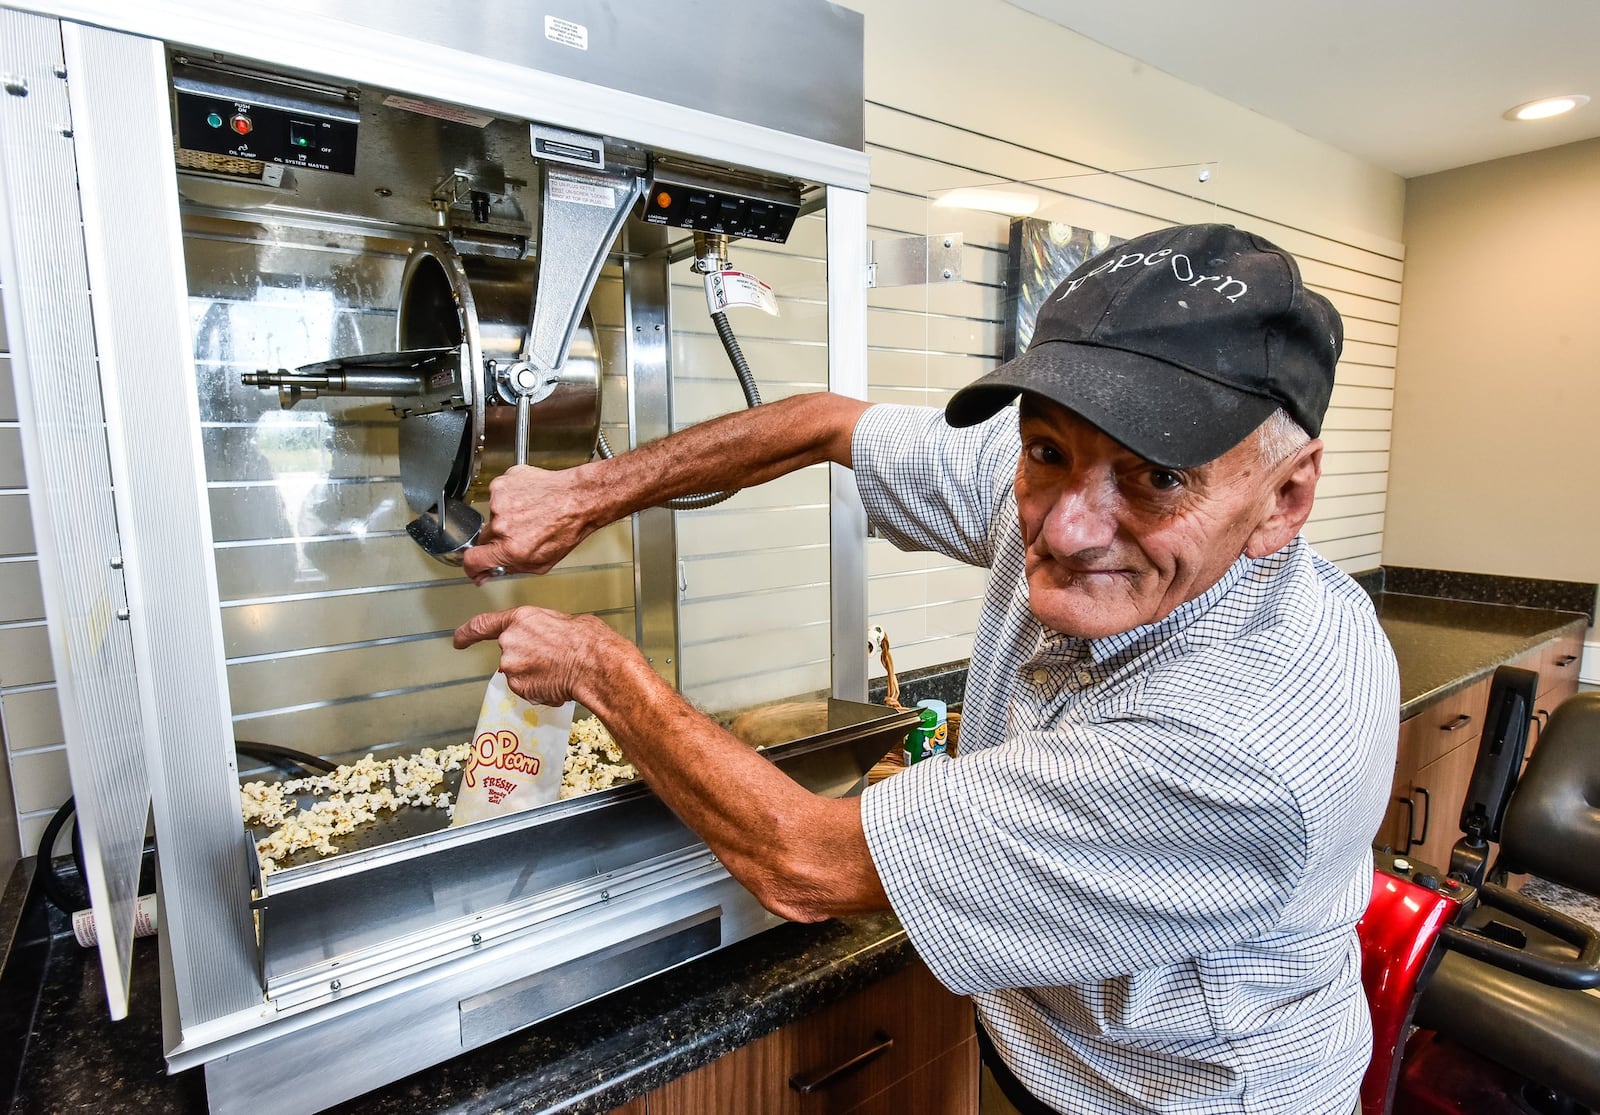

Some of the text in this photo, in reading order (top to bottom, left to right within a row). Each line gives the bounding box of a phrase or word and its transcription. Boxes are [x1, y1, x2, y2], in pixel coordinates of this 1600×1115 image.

[285, 159, 307, 167] SYSTEM
[307, 162, 329, 170] MASTER
[483, 775, 518, 795] FRESH!
[488, 788, 507, 798] Ready
